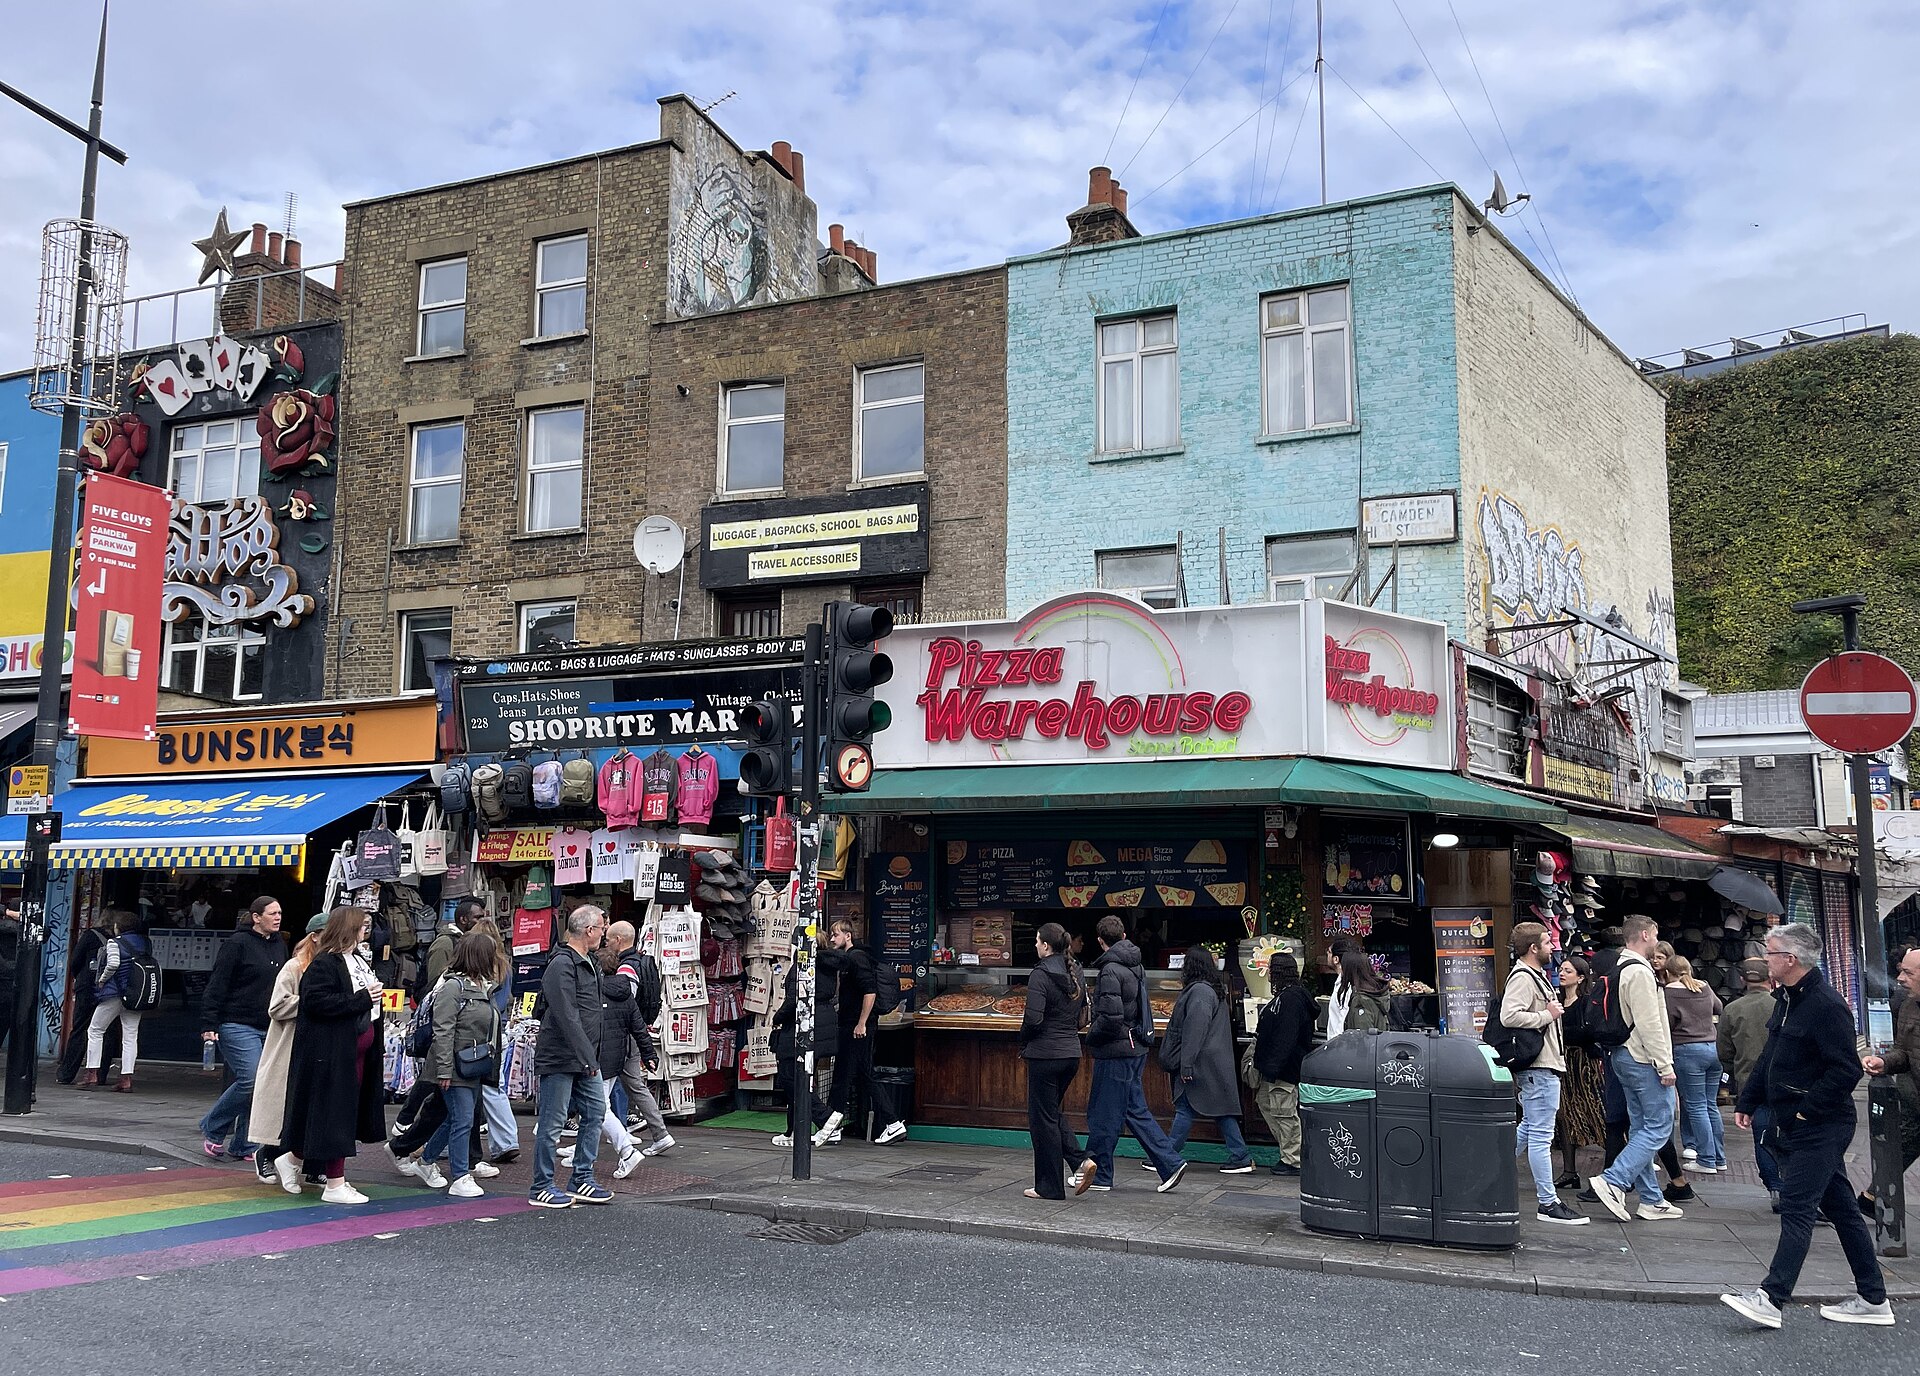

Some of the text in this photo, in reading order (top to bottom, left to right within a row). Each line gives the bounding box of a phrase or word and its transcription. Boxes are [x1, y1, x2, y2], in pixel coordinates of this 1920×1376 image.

[92, 504, 152, 526] FIVE GUYS
[1381, 507, 1434, 523] CAMDEN
[91, 525, 128, 539] CAMDEN
[712, 513, 918, 542] LUGGAGE BAGPACKS, SCHOOL BAGS AND
[92, 538, 133, 552] PARKWAY
[104, 557, 117, 565] MIN
[118, 560, 136, 569] WALK
[751, 552, 858, 570] TRAVEL ACCESSORIES
[531, 660, 553, 671] ACC.
[561, 659, 586, 670] BAGS
[588, 658, 596, 668] &
[598, 653, 643, 667] LUGGAGE
[650, 650, 675, 661] HATS
[683, 644, 749, 659] SUNGLASSES
[756, 641, 785, 654] BODY
[925, 636, 1066, 689] Pizza
[462, 665, 477, 673] 228
[706, 694, 752, 707] Vintage
[498, 707, 527, 718] Jeans
[537, 704, 579, 717] Leather
[916, 680, 1252, 750] Warehouse
[471, 717, 489, 729] 228
[508, 713, 656, 742] SHOPRITE
[1127, 736, 1238, 754] Stone Baked
[644, 768, 672, 783] LONDON
[647, 799, 663, 816] £15
[526, 850, 537, 858] for
[560, 845, 565, 858] I
[598, 843, 603, 855] I
[992, 848, 1014, 858] PIZZA
[1117, 847, 1153, 862] MEGA
[1154, 846, 1173, 854] Pizza
[480, 852, 508, 861] Magnets
[558, 856, 580, 870] LONDON
[596, 854, 619, 866] LONDON
[1154, 854, 1172, 862] Slice
[659, 880, 685, 889] NEED SEX
[876, 880, 923, 895] Burger MENU
[664, 934, 683, 944] TOWN
[772, 929, 790, 939] STREET
[1442, 929, 1469, 937] DUTCH
[900, 964, 913, 973] DOG
